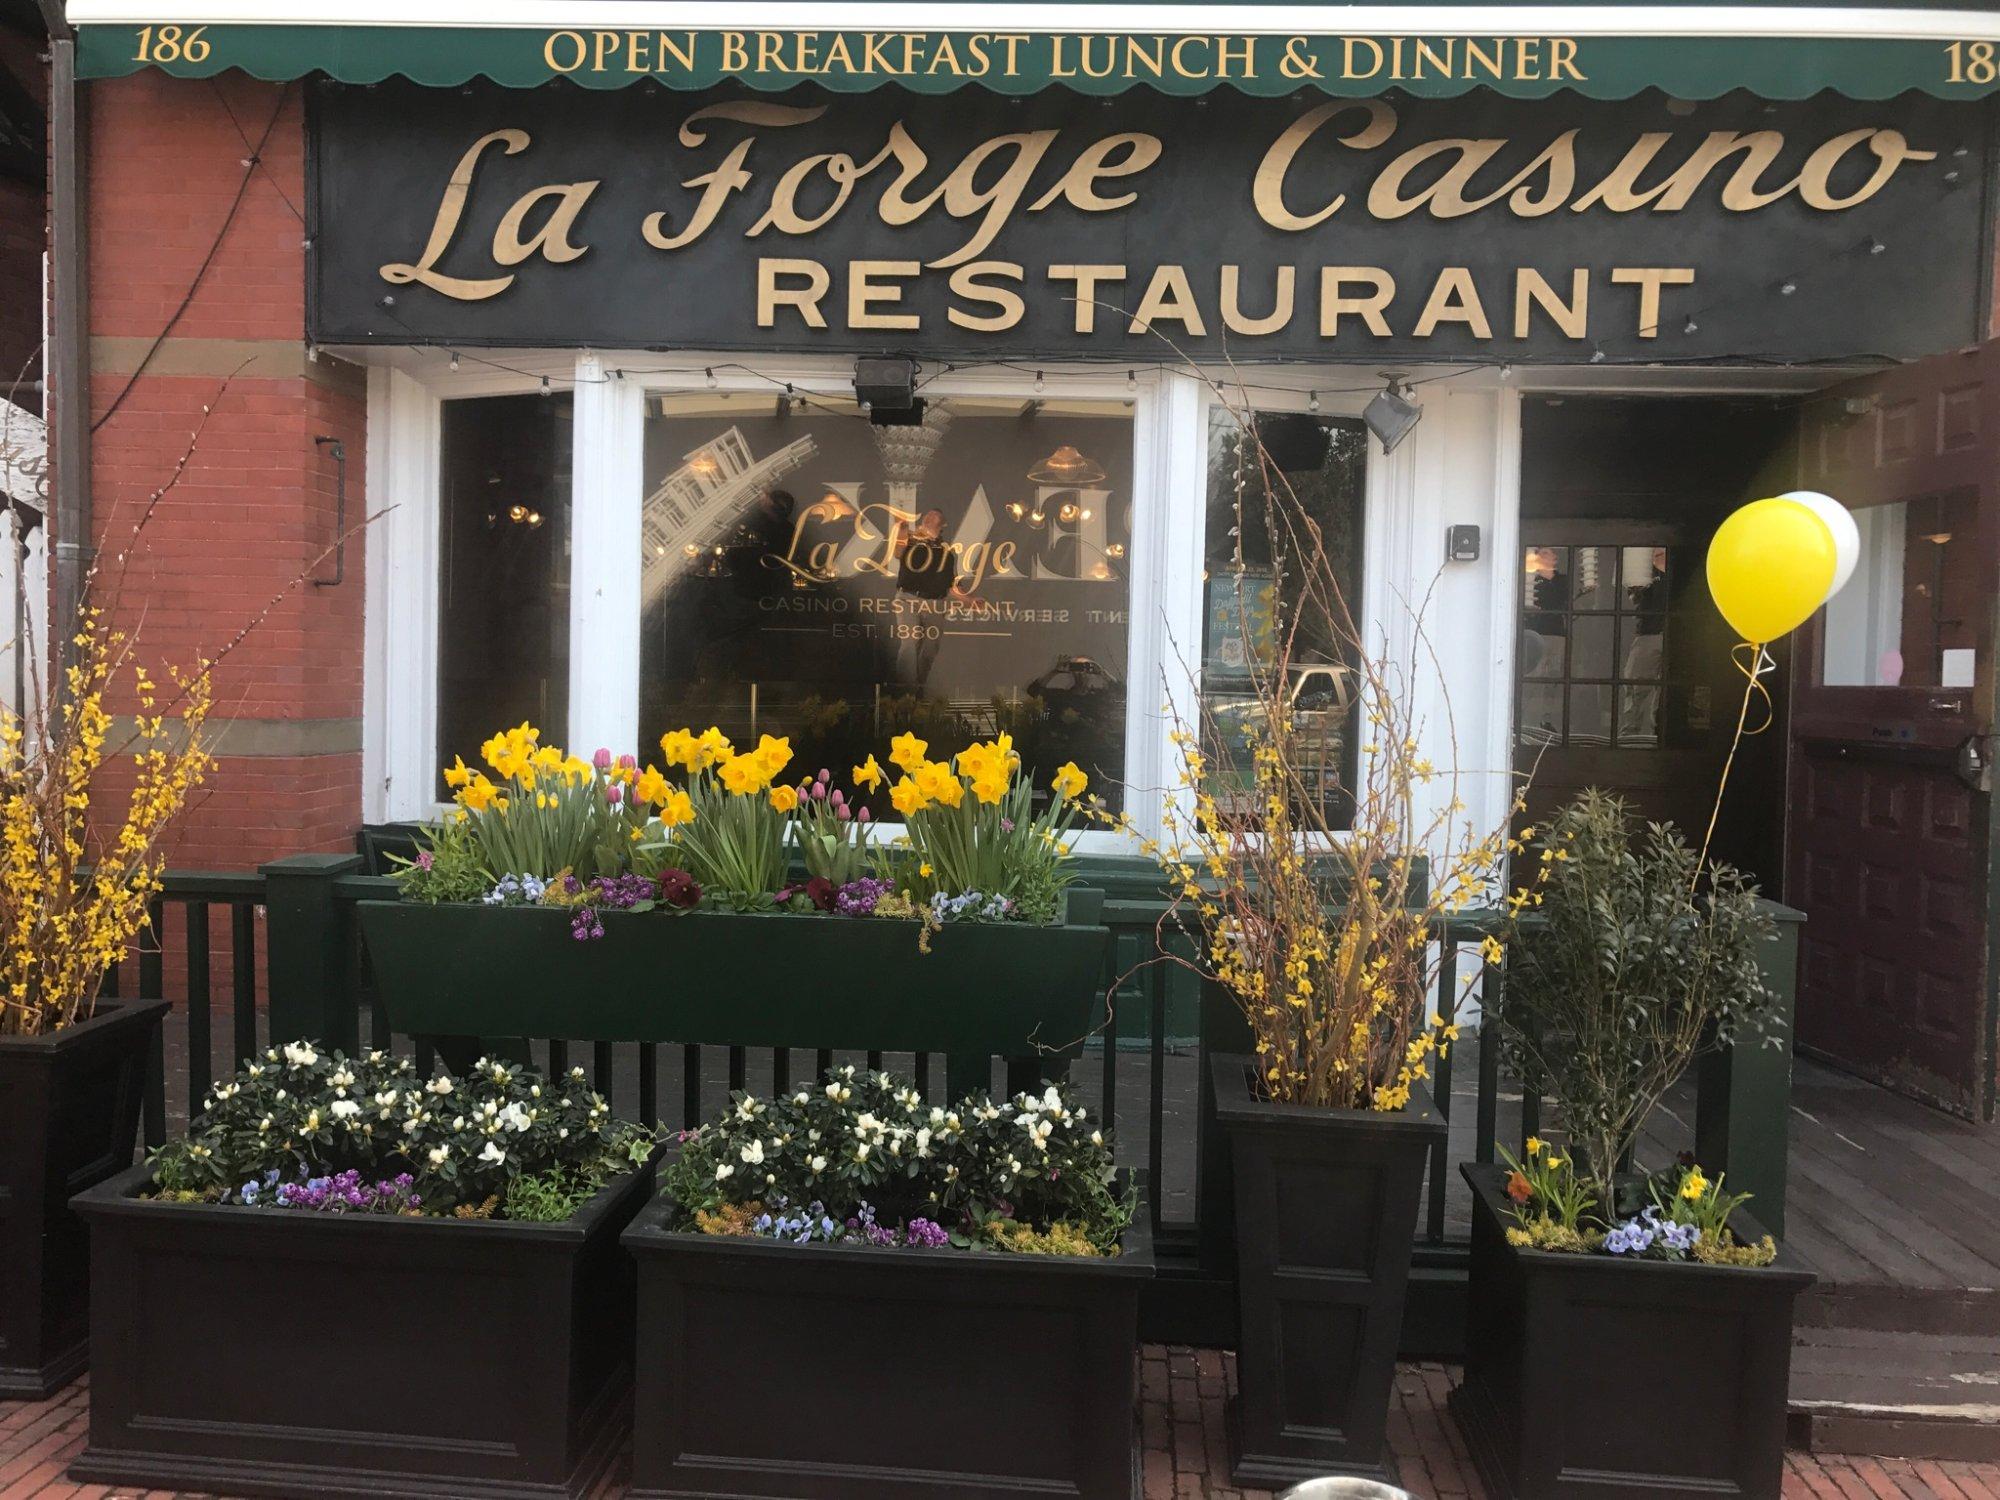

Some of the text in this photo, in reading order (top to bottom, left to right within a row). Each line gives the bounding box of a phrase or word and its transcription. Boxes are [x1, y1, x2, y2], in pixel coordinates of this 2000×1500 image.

[133, 26, 211, 63] 186
[543, 31, 1588, 81] OPEN BREAKFAST LUNCH & DINNER
[1943, 41, 2000, 84] 18
[379, 101, 1937, 301] La Forge Casino
[756, 257, 1695, 340] RESTAURANT
[760, 502, 1018, 596] La Forge
[758, 596, 1015, 617] CASINO RESTAURANT
[832, 624, 940, 641] EST. 1880
